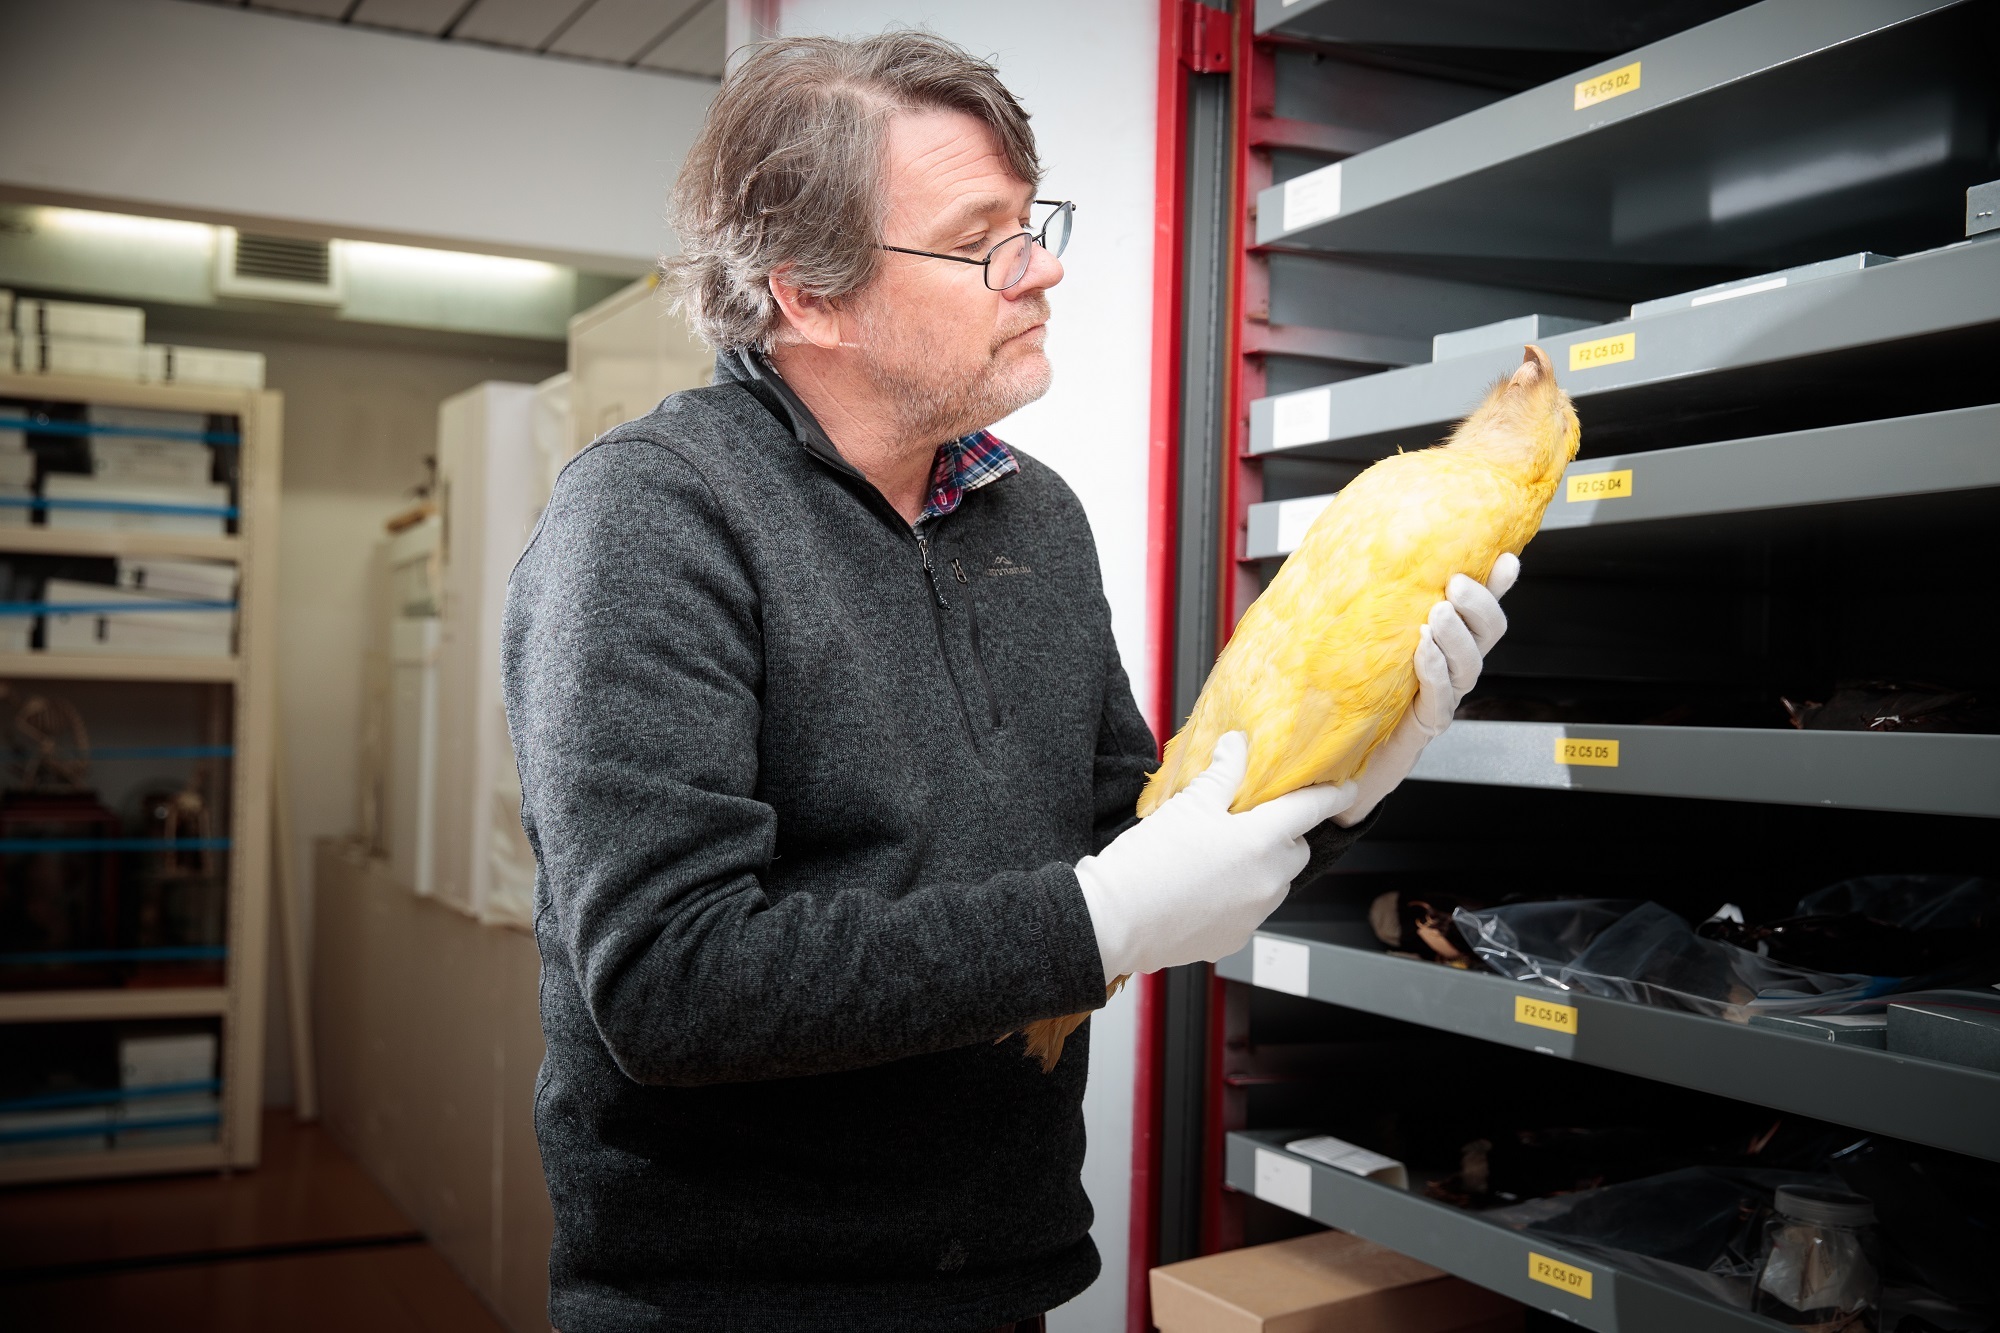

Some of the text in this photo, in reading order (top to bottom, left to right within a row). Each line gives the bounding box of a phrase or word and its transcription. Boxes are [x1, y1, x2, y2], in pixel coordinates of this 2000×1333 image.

[1584, 73, 1630, 98] F2 C5 D2
[1579, 342, 1624, 361] F2 C5 D3
[1576, 478, 1621, 493] F2 C5 D4
[1564, 745, 1609, 758] F2 C5 D5
[1524, 1004, 1568, 1024] F2 C5 D6
[1538, 1262, 1583, 1287] F2 C5 D7
